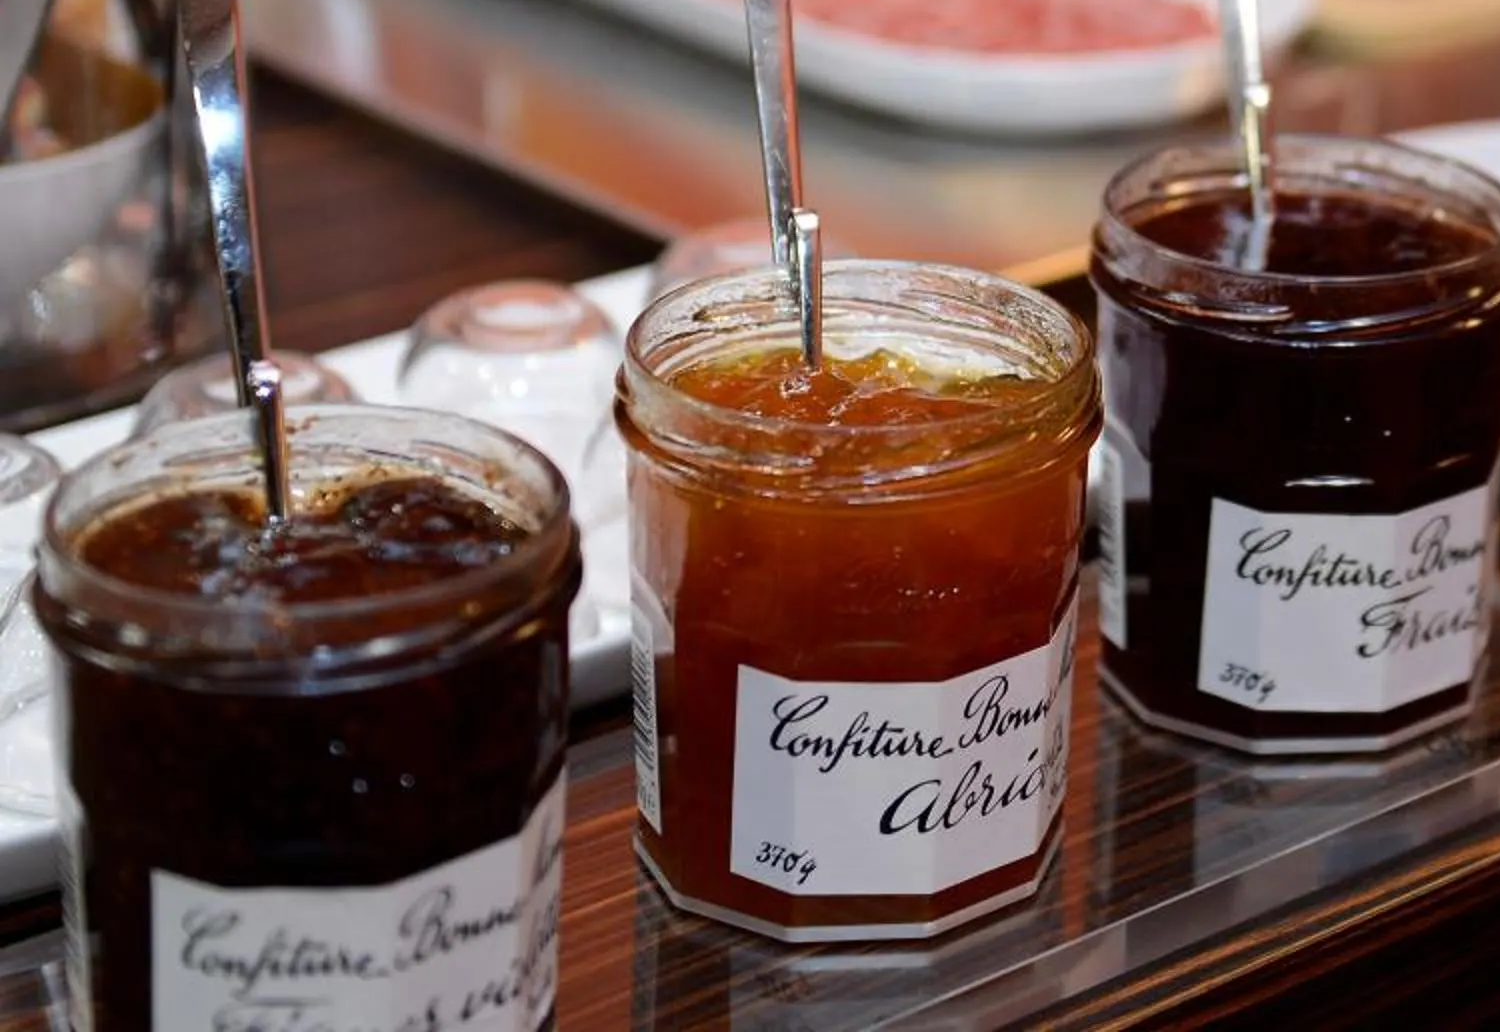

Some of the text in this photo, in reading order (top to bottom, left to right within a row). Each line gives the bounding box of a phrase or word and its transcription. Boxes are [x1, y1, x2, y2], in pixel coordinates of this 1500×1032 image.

[1236, 527, 1402, 602] Confiture
[769, 694, 953, 773] Confiture
[755, 841, 817, 885] 370g
[180, 906, 391, 1004] Confiture
